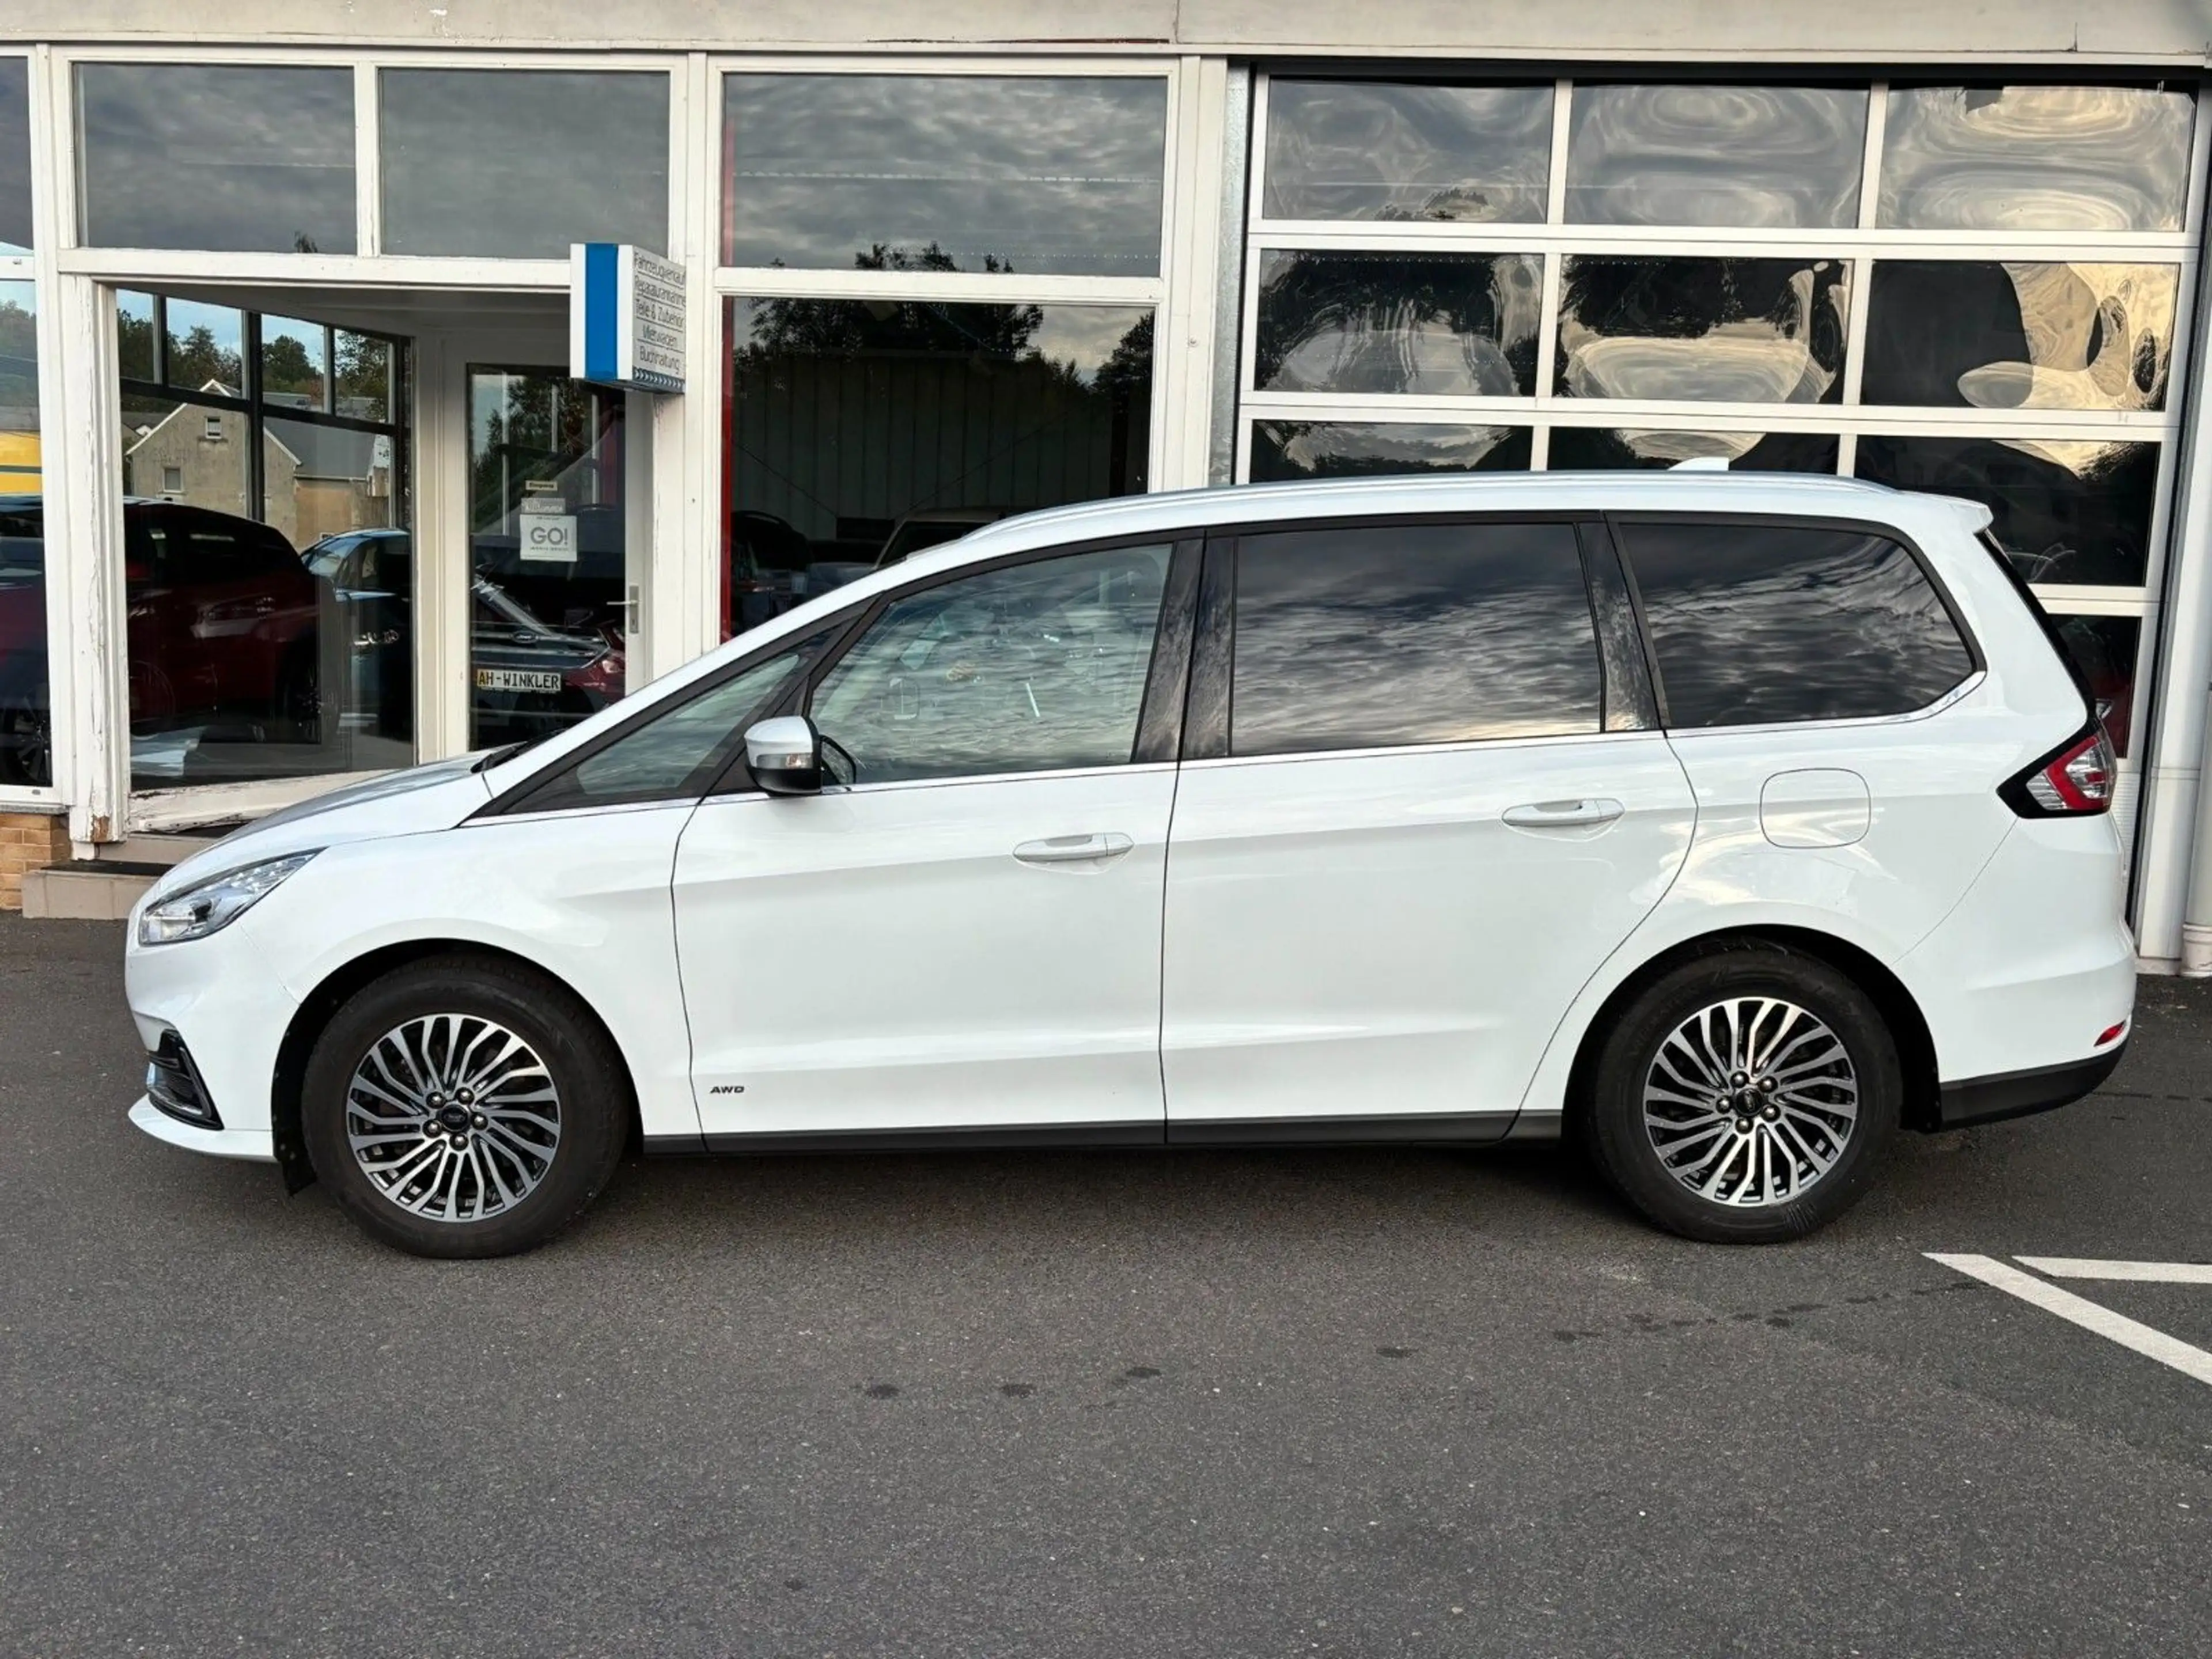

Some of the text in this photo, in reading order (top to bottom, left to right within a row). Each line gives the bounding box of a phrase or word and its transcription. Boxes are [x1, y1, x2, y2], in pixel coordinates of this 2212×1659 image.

[531, 527, 567, 546] GO!
[479, 671, 559, 689] AH-WINKLER
[710, 1086, 745, 1094] AWD
